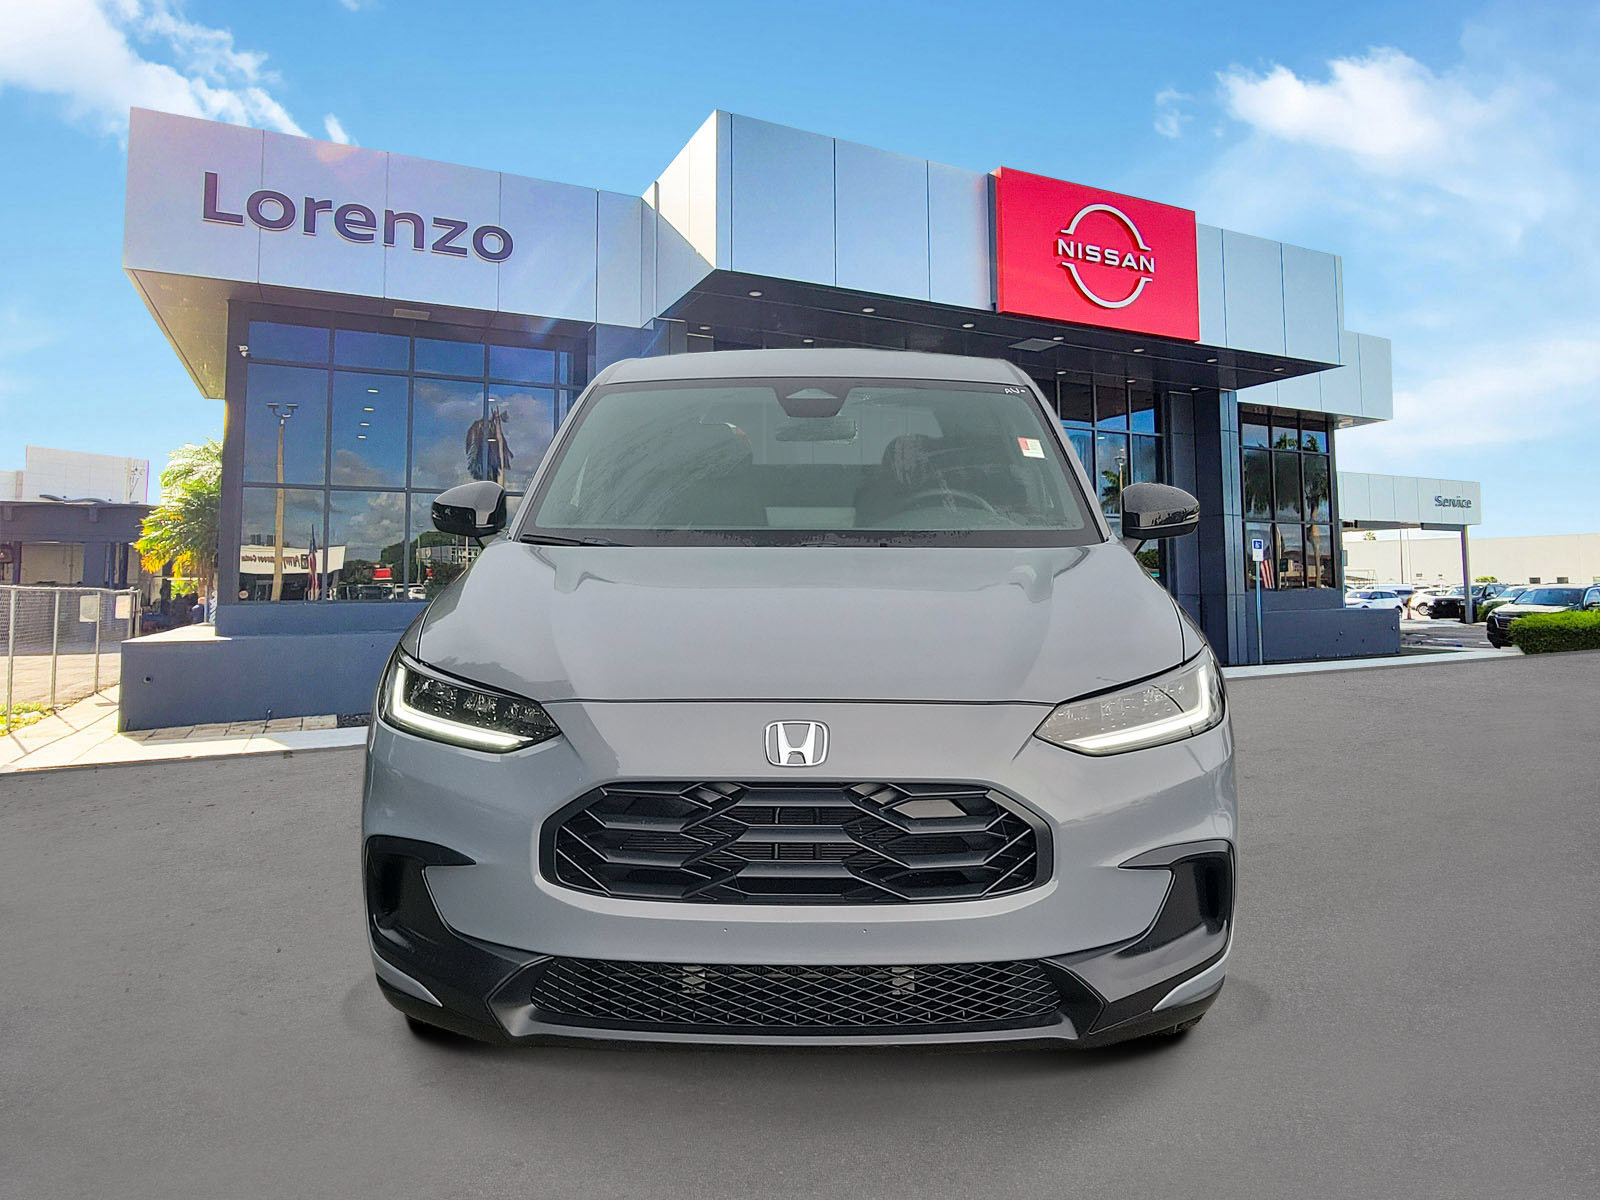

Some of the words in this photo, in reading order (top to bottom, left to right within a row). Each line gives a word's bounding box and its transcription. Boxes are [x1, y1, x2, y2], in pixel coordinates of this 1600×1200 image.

[202, 171, 514, 262] Lorenzo
[1057, 238, 1155, 273] NISSAN
[1434, 495, 1472, 508] Service
